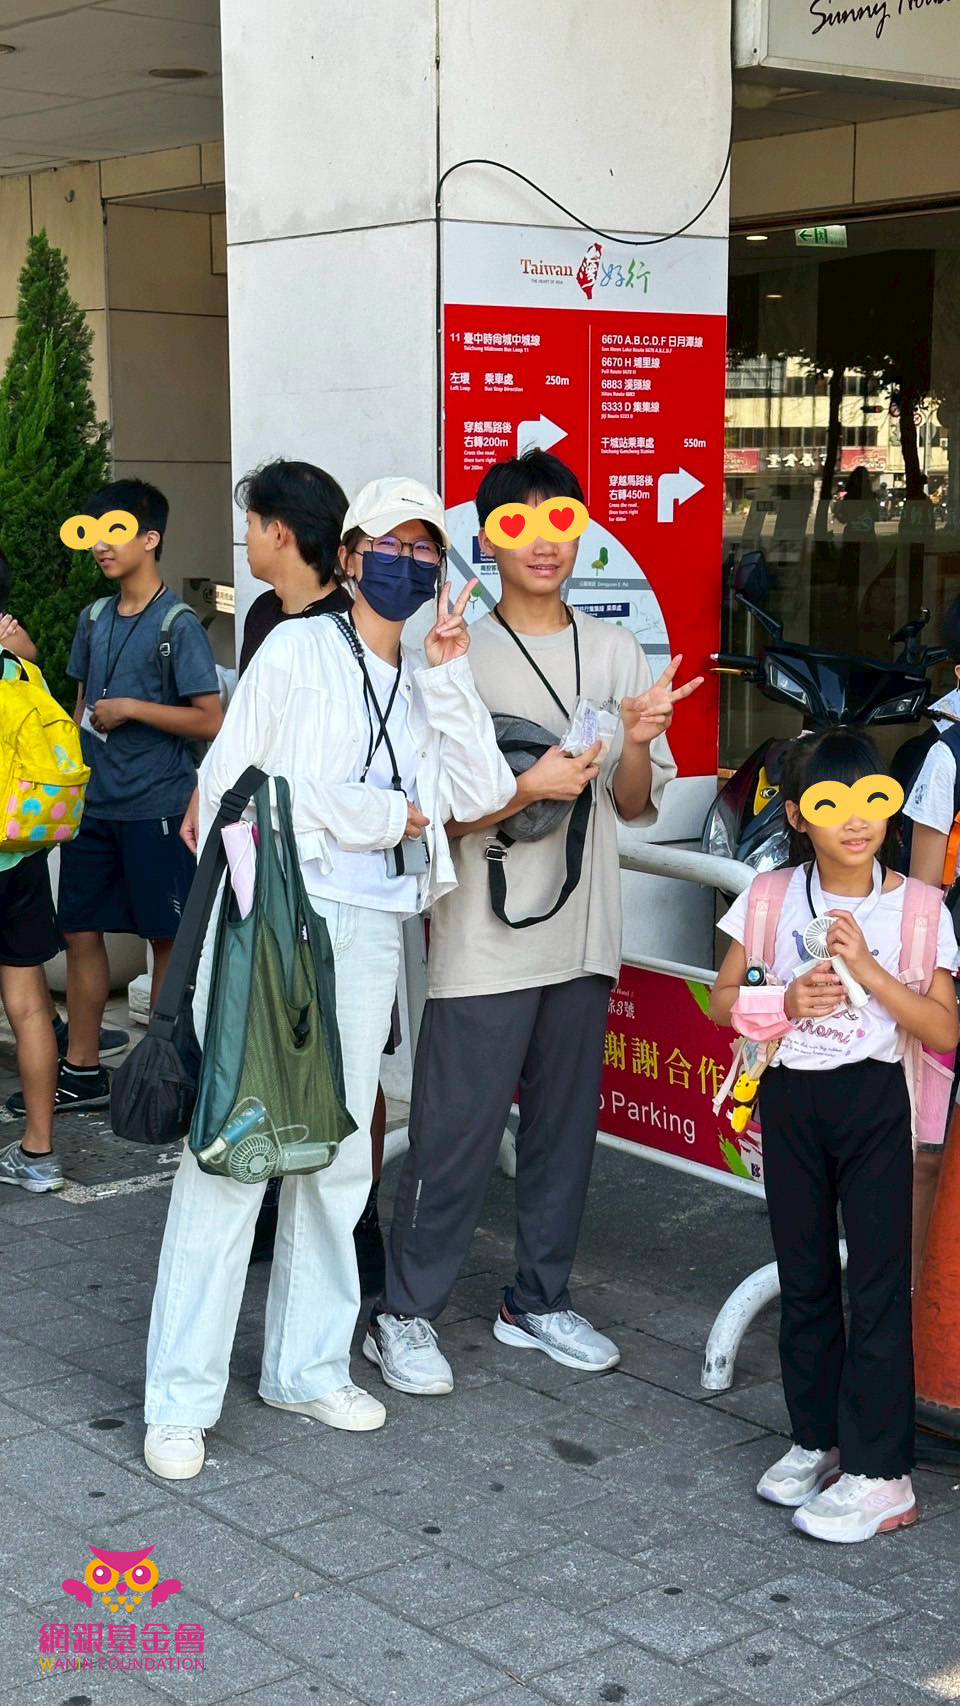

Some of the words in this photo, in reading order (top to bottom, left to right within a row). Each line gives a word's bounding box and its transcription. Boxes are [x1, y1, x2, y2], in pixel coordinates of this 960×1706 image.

[809, 0, 890, 38] Sunny
[520, 258, 574, 277] Taiwan
[600, 257, 652, 294] 好行
[450, 333, 460, 341] 11
[602, 335, 623, 344] 6670
[625, 336, 666, 345] A.B.C.D.F
[602, 357, 622, 366] 6670
[625, 358, 631, 366] H
[546, 376, 569, 385] 250m
[602, 380, 622, 389] 6883
[602, 402, 622, 411] 6333
[625, 402, 631, 411] D
[464, 421, 511, 433] 穿越馬路後
[464, 436, 508, 447] 右轉200m
[684, 439, 706, 447] 550m
[609, 475, 653, 486] 穿越馬路後
[609, 489, 649, 500] 右轉450m
[602, 1030, 726, 1097] 謝謝合作
[611, 1090, 695, 1144] Parking
